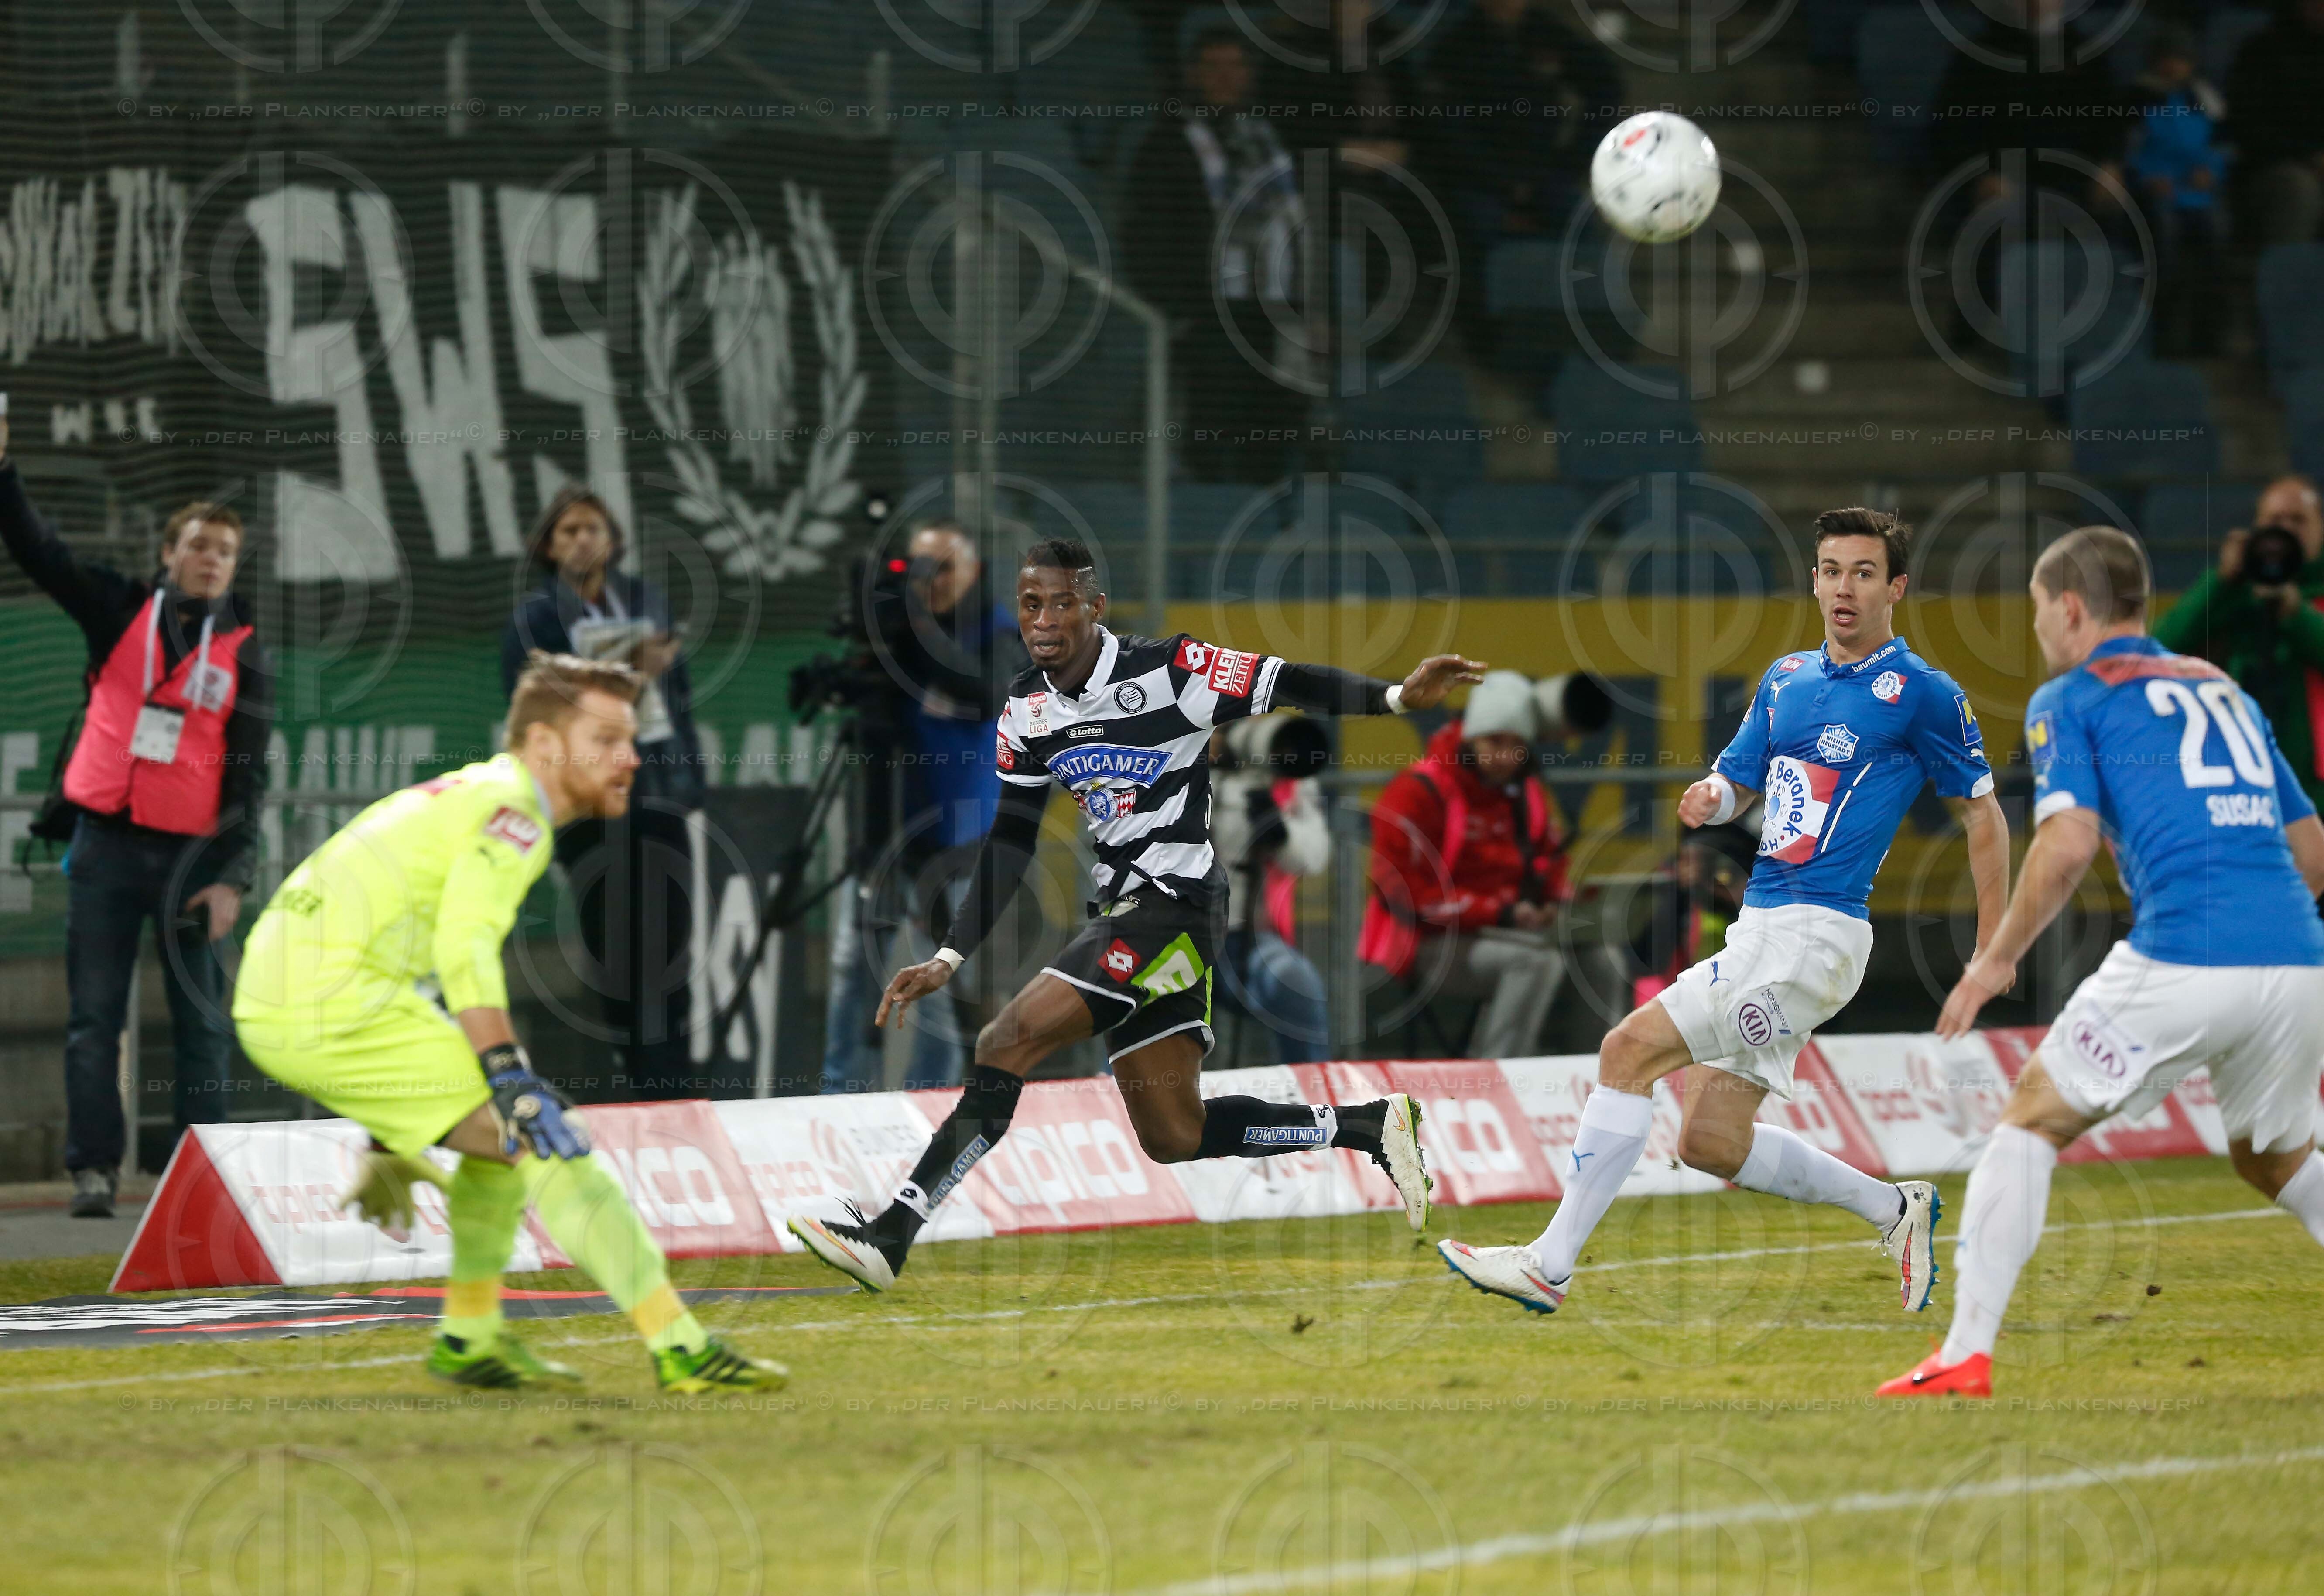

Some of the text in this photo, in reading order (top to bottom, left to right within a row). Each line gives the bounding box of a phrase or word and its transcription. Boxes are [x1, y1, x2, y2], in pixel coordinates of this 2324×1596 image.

[1852, 645, 1896, 673] baumit.com
[1030, 724, 1049, 734] LIGA
[1078, 727, 1102, 735] lotto
[2145, 679, 2275, 788] 20
[1821, 740, 1850, 754] NEUSTADT
[1826, 735, 1848, 747] WIENER
[1776, 761, 1805, 836] Beranek
[1742, 1008, 1766, 1042] KIA
[1249, 1130, 1323, 1142] PUNTIGAMER
